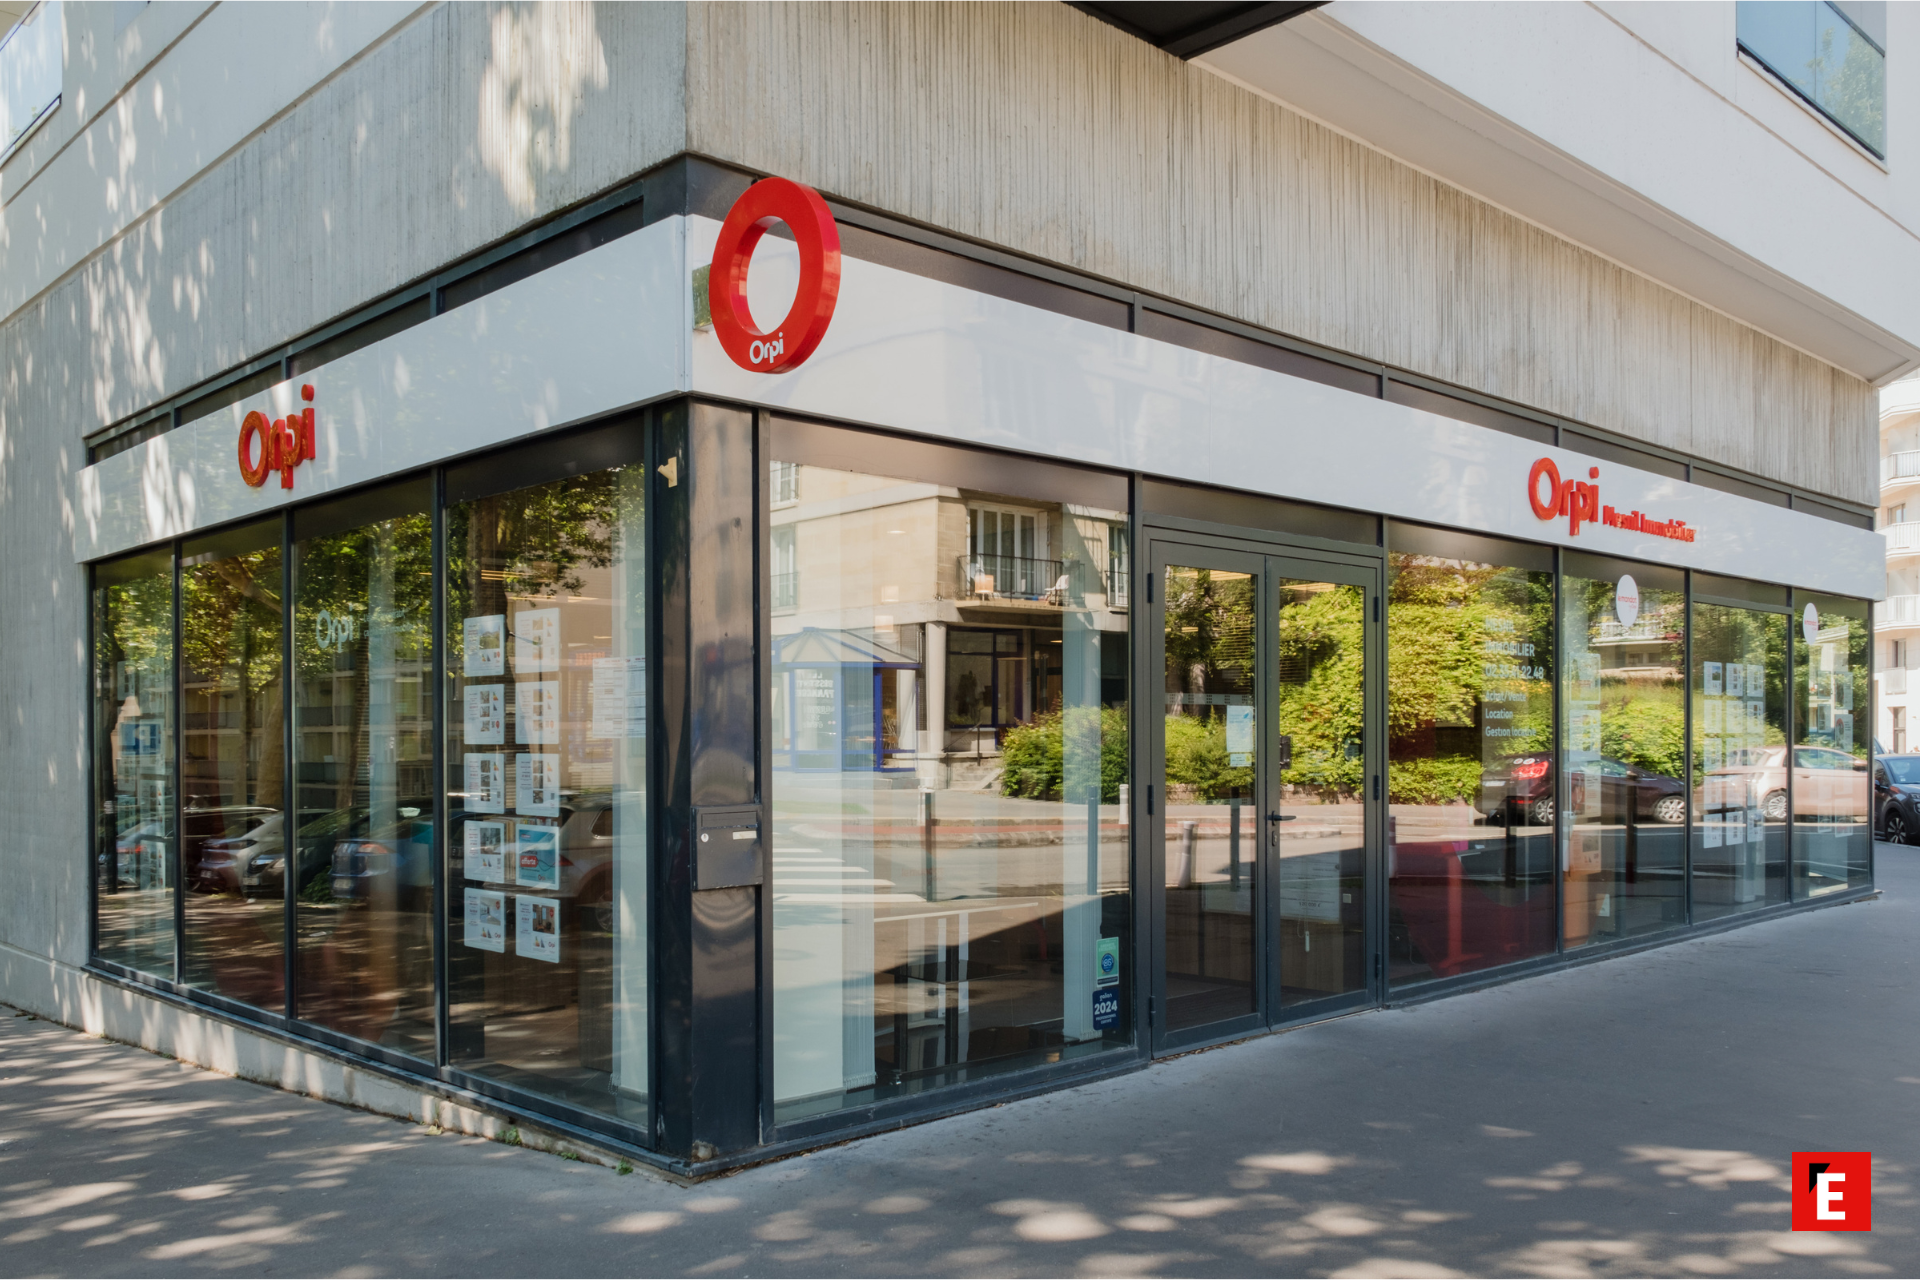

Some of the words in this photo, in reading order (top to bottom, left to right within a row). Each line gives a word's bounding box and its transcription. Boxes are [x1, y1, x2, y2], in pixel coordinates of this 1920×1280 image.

[749, 332, 784, 365] Orpi
[238, 384, 316, 489] Orpi
[1528, 457, 1599, 536] Orpi
[1603, 505, 1639, 531] Mesnil
[316, 602, 354, 653] Orpi
[1485, 641, 1535, 657] IMMOBILIER
[1485, 708, 1513, 720] Location
[1485, 726, 1511, 737] Gestion
[1094, 1000, 1118, 1015] 2024
